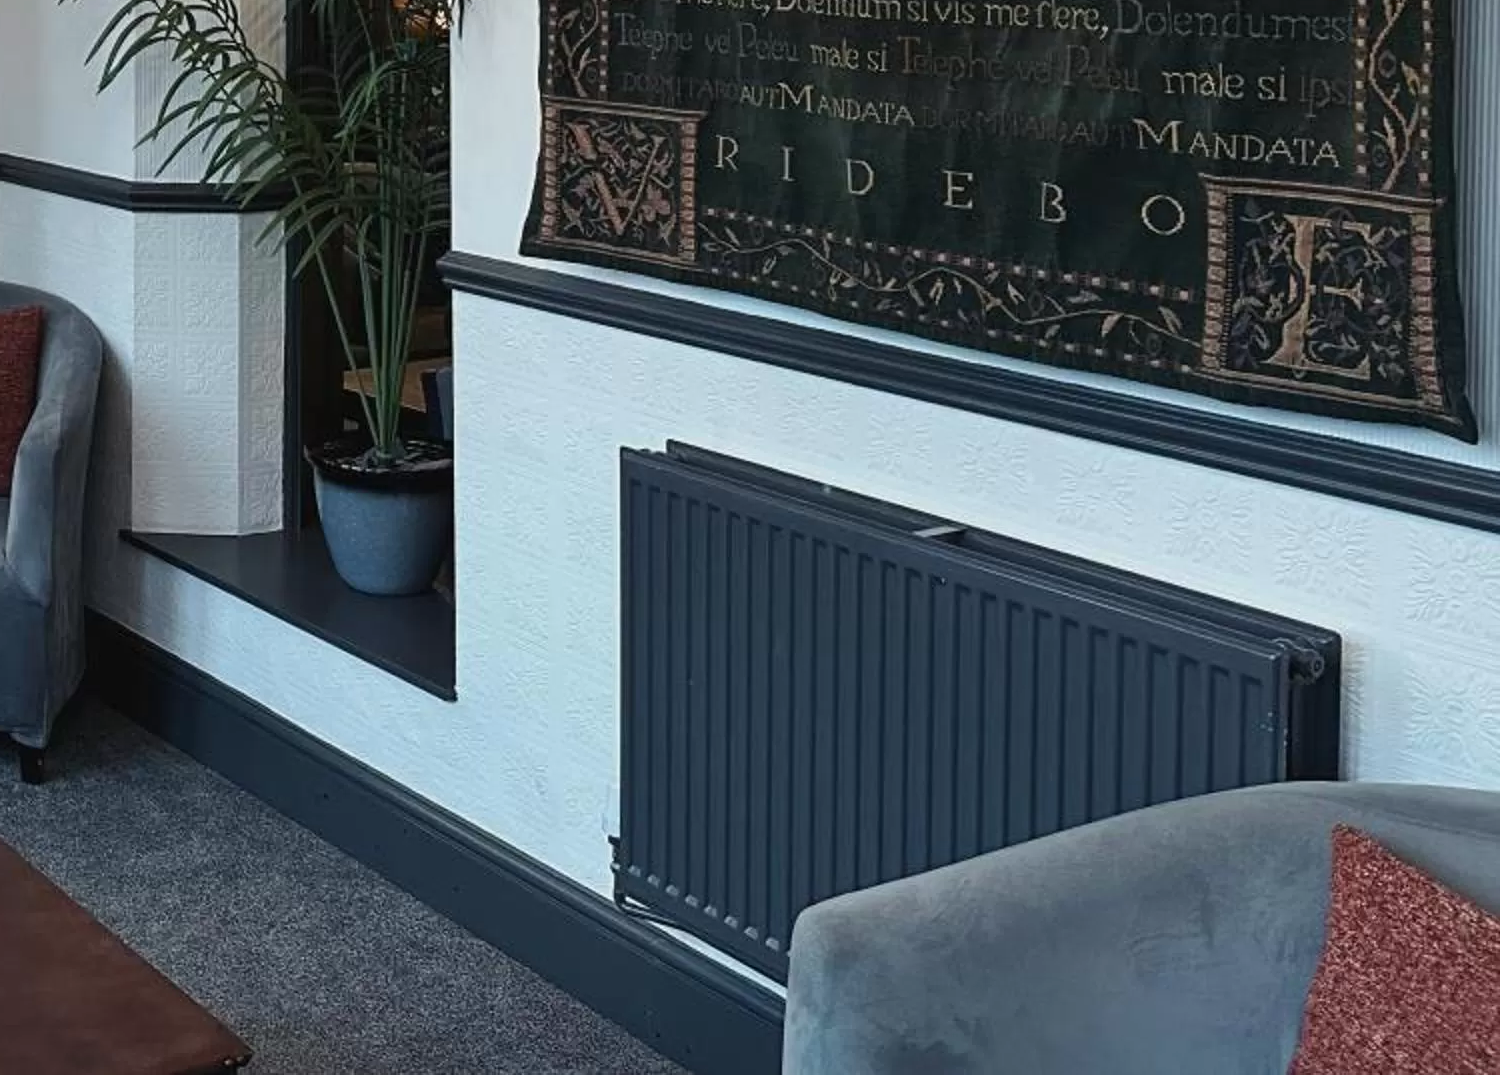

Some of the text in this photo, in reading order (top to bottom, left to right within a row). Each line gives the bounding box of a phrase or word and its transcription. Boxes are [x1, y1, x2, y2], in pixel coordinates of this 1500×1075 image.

[983, 1, 1030, 27] me
[809, 36, 860, 72] male
[866, 41, 889, 73] si
[1161, 61, 1245, 101] male
[1257, 65, 1288, 102] si
[1131, 116, 1341, 169] MANDATA
[714, 133, 1187, 237] RIDEBO
